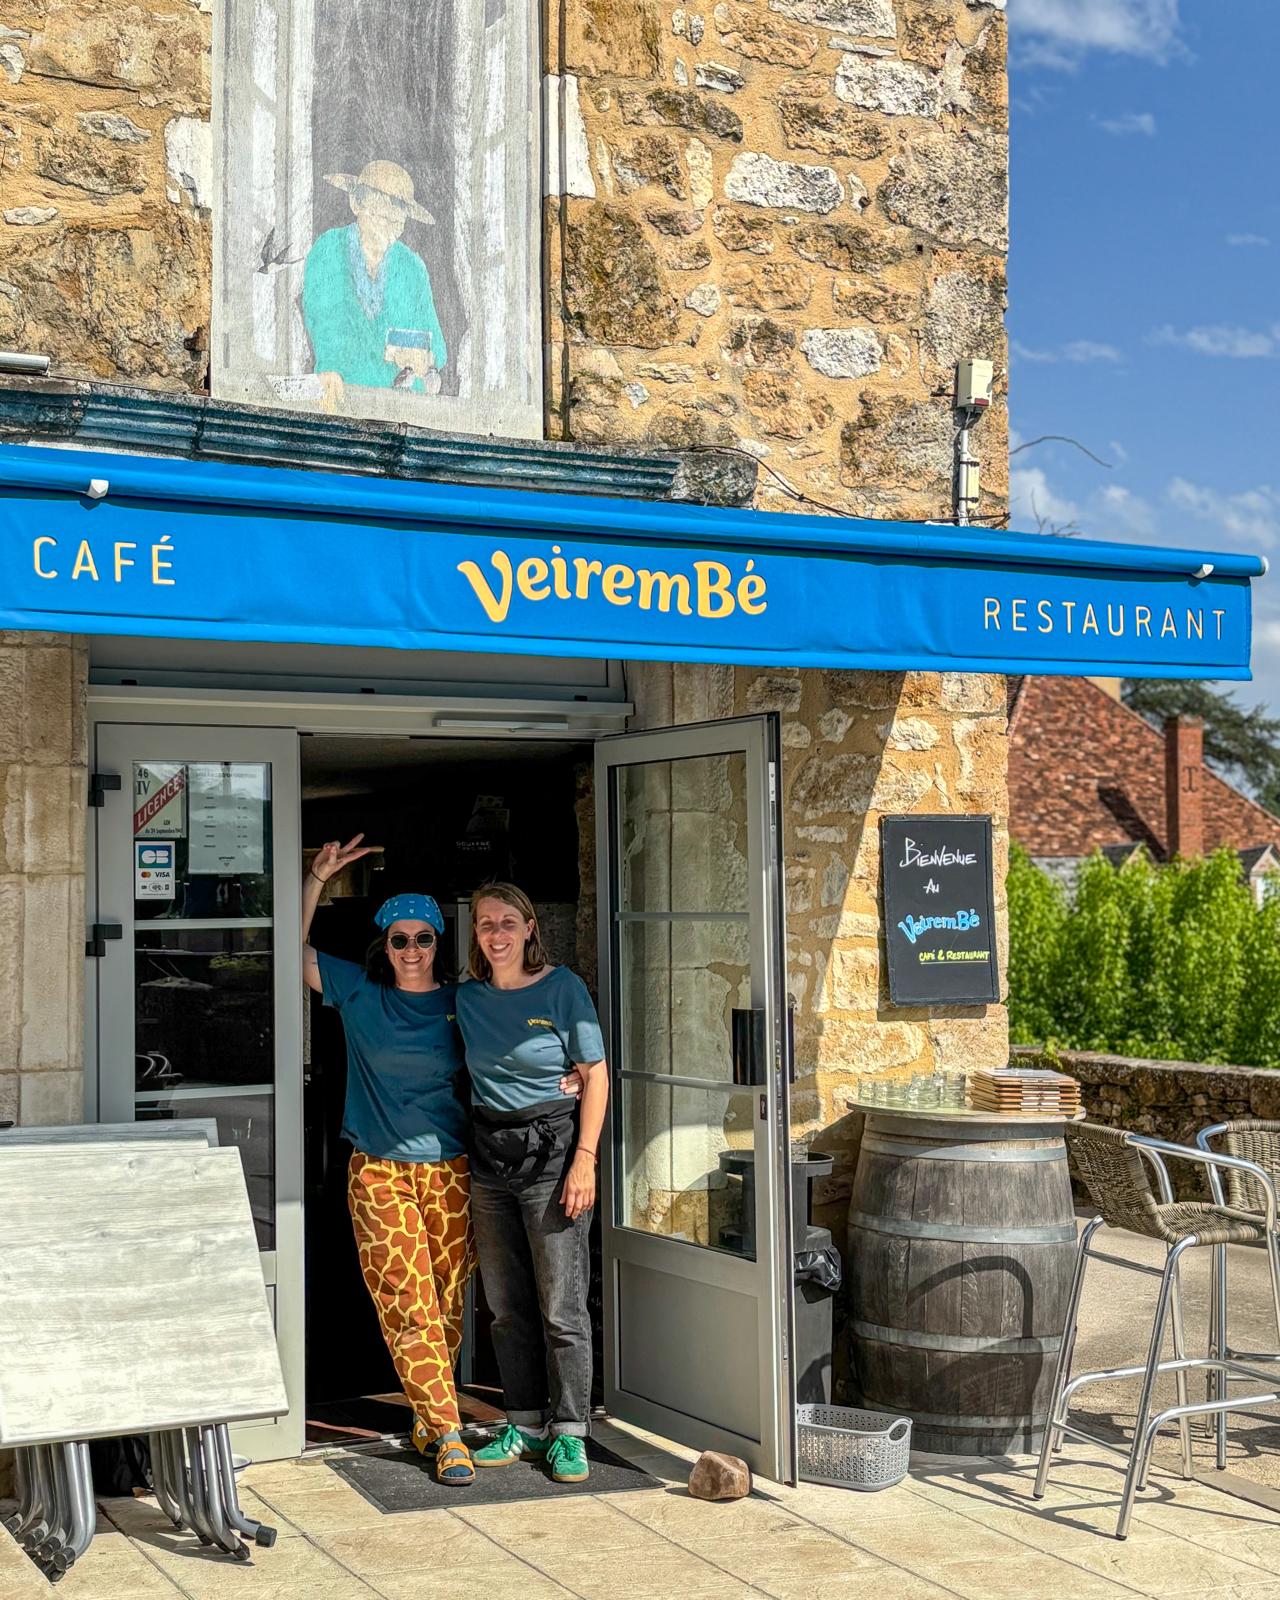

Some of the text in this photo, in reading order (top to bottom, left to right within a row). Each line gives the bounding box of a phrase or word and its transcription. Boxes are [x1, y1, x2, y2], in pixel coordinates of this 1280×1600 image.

[33, 535, 176, 586] CAFÉ
[457, 545, 768, 623] VeiremBé
[984, 597, 1226, 641] RESTAURANT
[136, 781, 151, 795] IV
[137, 768, 149, 778] 46
[898, 908, 980, 944] VeiremBé
[937, 949, 945, 961] &
[946, 950, 990, 961] RESTAURANT
